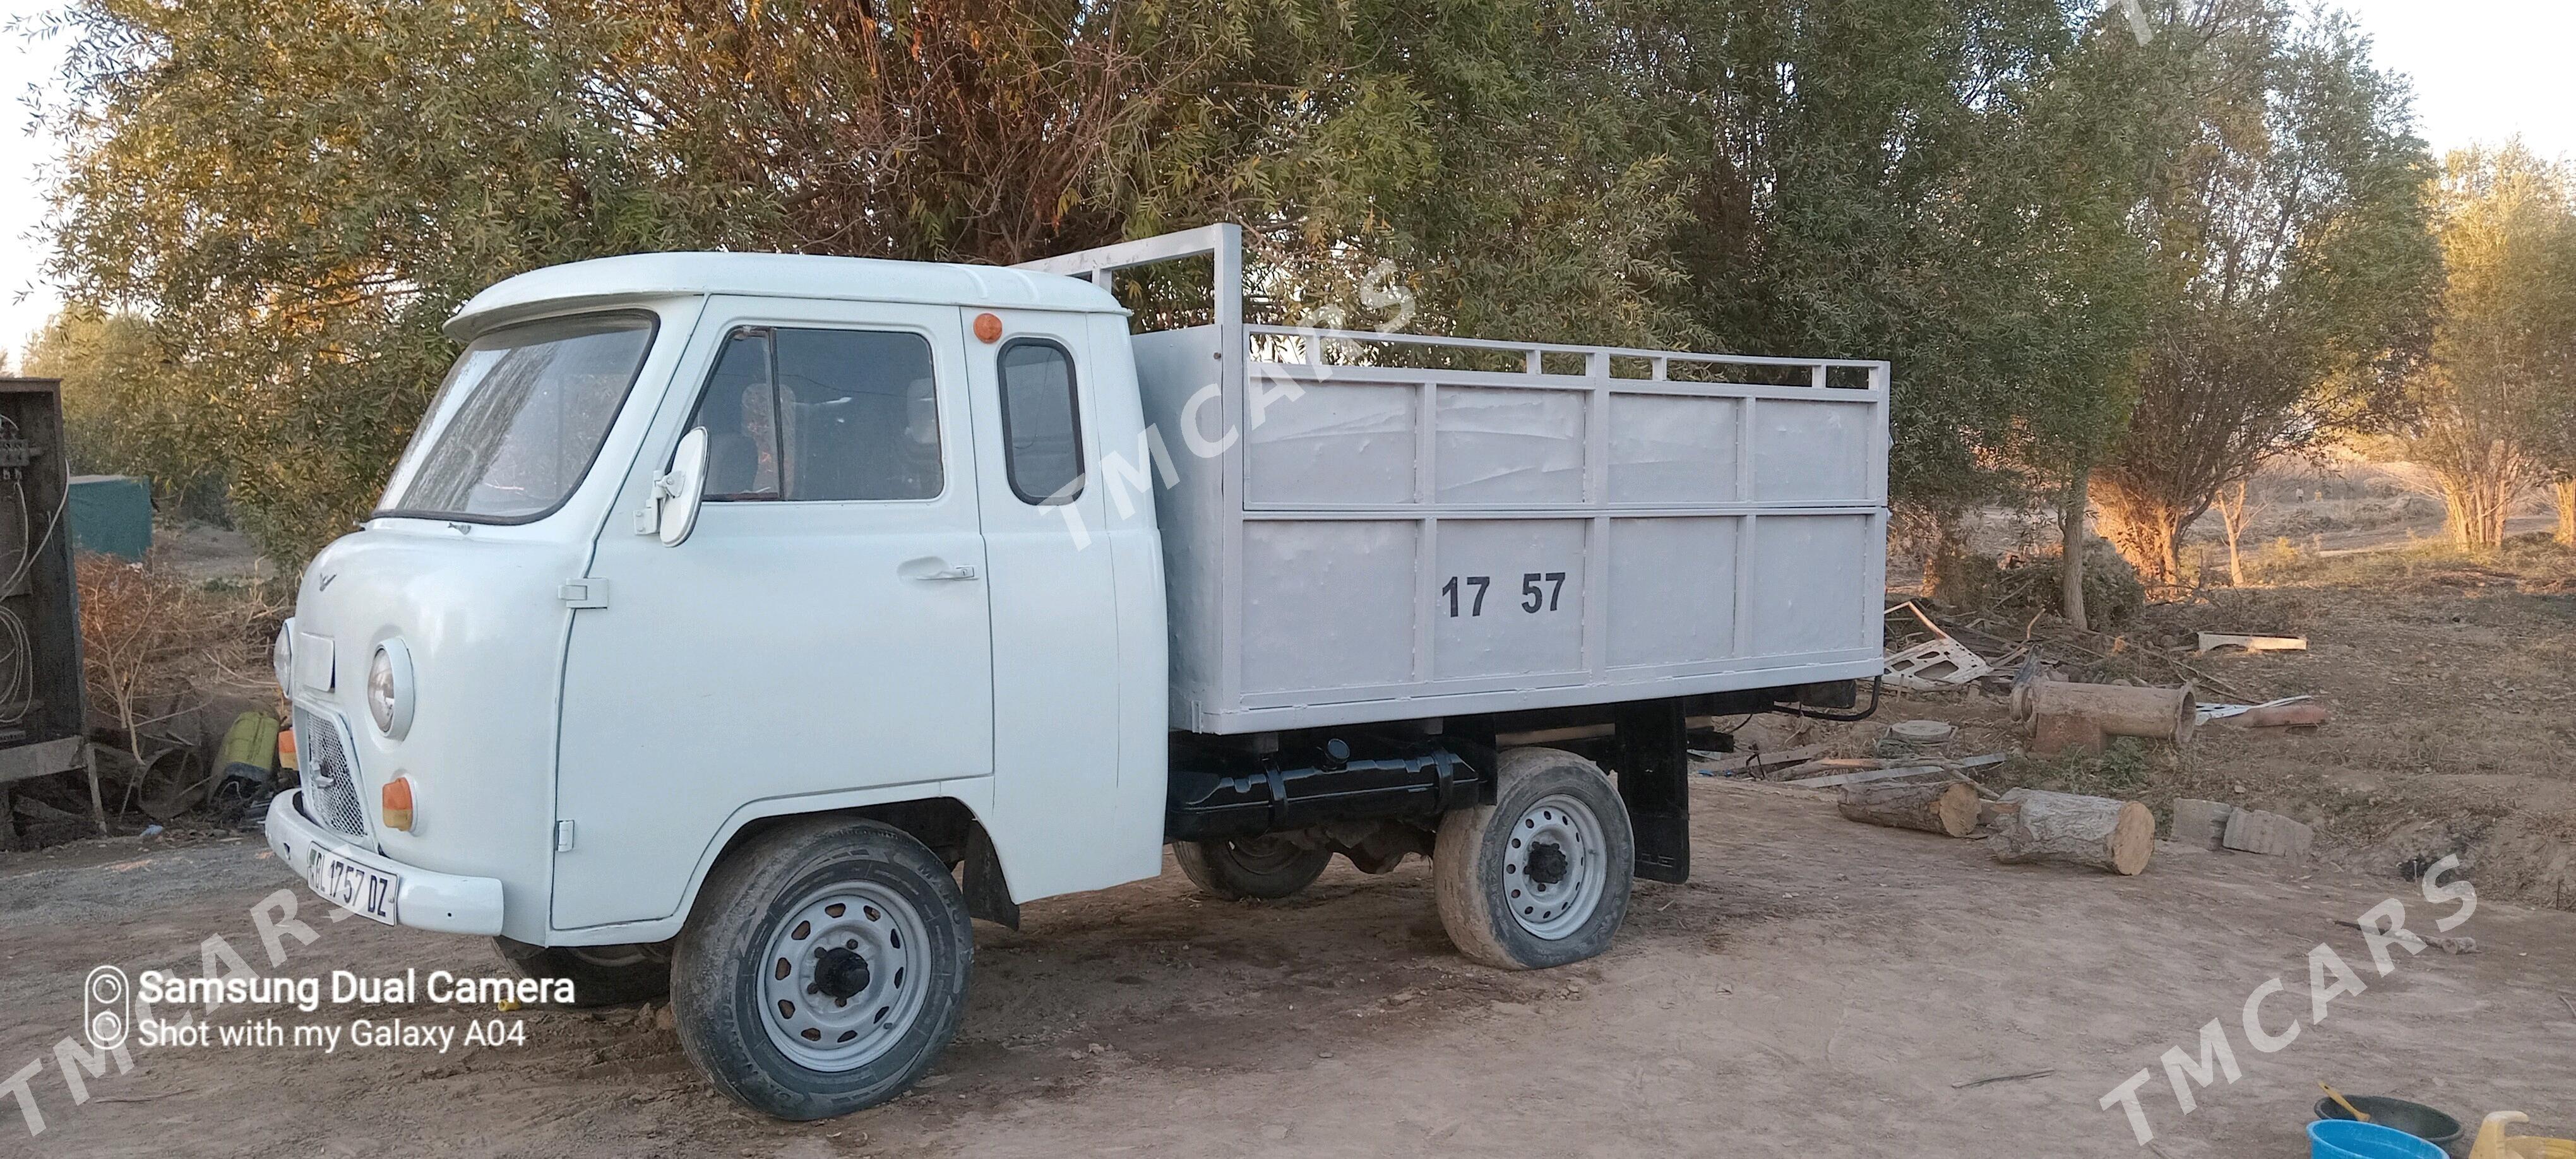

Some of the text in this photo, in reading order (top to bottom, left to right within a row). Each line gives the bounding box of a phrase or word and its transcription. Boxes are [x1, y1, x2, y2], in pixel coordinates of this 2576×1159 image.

[1441, 572, 1566, 618] 17 57
[330, 859, 365, 906] 1757
[367, 874, 388, 917] DZ
